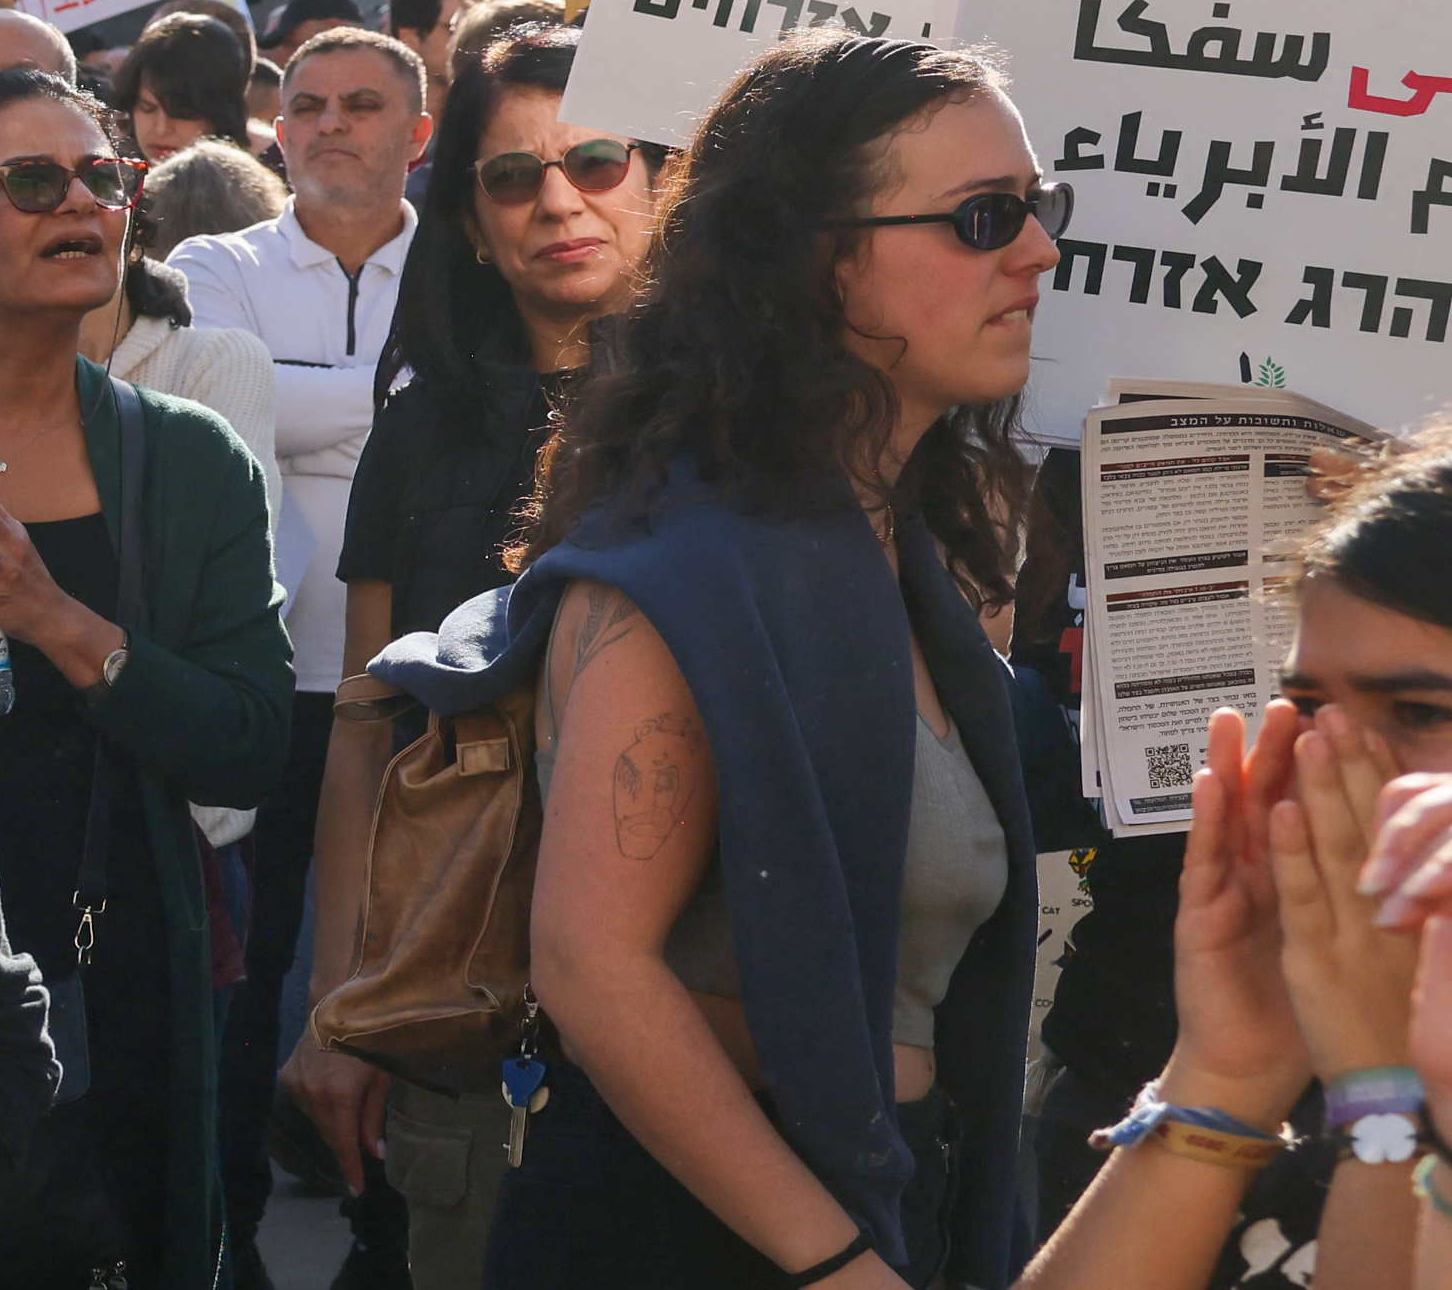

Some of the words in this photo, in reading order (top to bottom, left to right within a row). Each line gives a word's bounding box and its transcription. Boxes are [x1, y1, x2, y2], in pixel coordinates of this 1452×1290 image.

[1054, 111, 1390, 225] الأبرياء
[1052, 238, 1264, 320] אזרח
[1169, 415, 1209, 428] המצב
[1214, 414, 1232, 426] על
[1237, 415, 1298, 428] ותשובות
[1303, 420, 1347, 438] שאלות
[1117, 704, 1141, 712] החמלה,
[1158, 699, 1189, 707] האנושיות,
